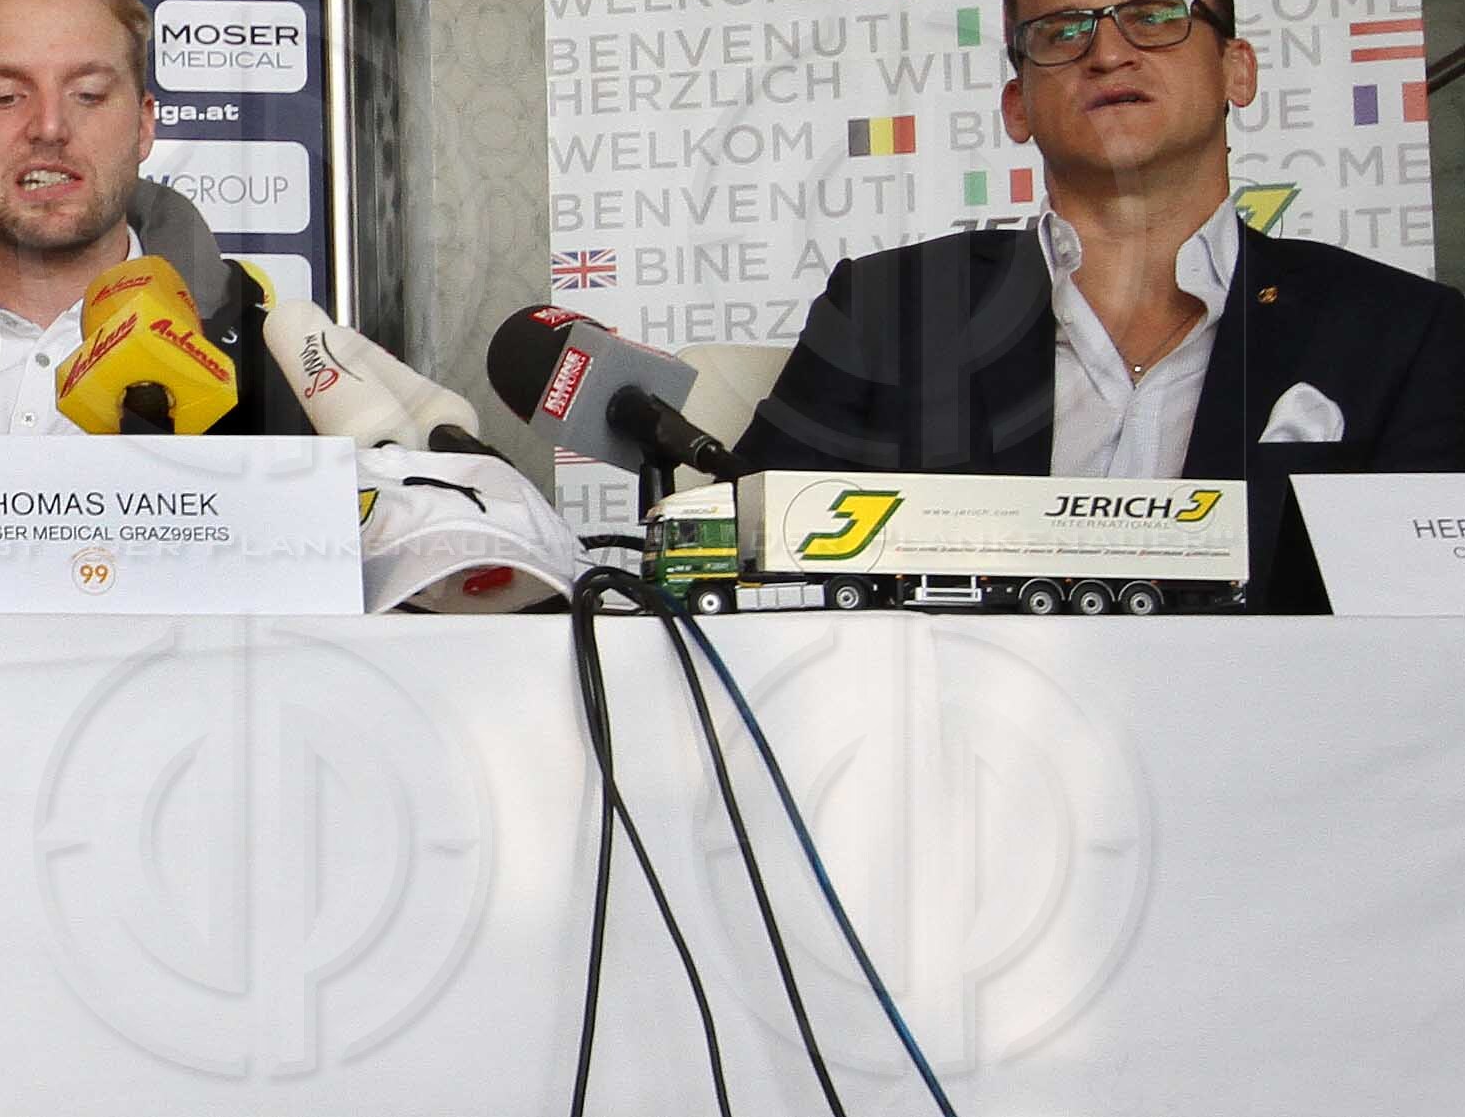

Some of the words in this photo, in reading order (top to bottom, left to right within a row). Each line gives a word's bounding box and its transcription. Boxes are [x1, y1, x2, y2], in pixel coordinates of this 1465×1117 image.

[162, 24, 299, 46] MOSER
[548, 12, 911, 77] BENVENUTI
[162, 50, 293, 69] MEDICAL
[551, 61, 841, 117] HERZLICH
[551, 121, 813, 175] WELKOM
[551, 171, 916, 233] BENVENUTI
[635, 242, 769, 287] BINE
[116, 492, 220, 516] VANEK
[1045, 496, 1170, 519] JERICH
[33, 526, 114, 541] MEDICAL
[119, 527, 230, 542] GRAZ99ERS
[80, 565, 108, 584] 99
